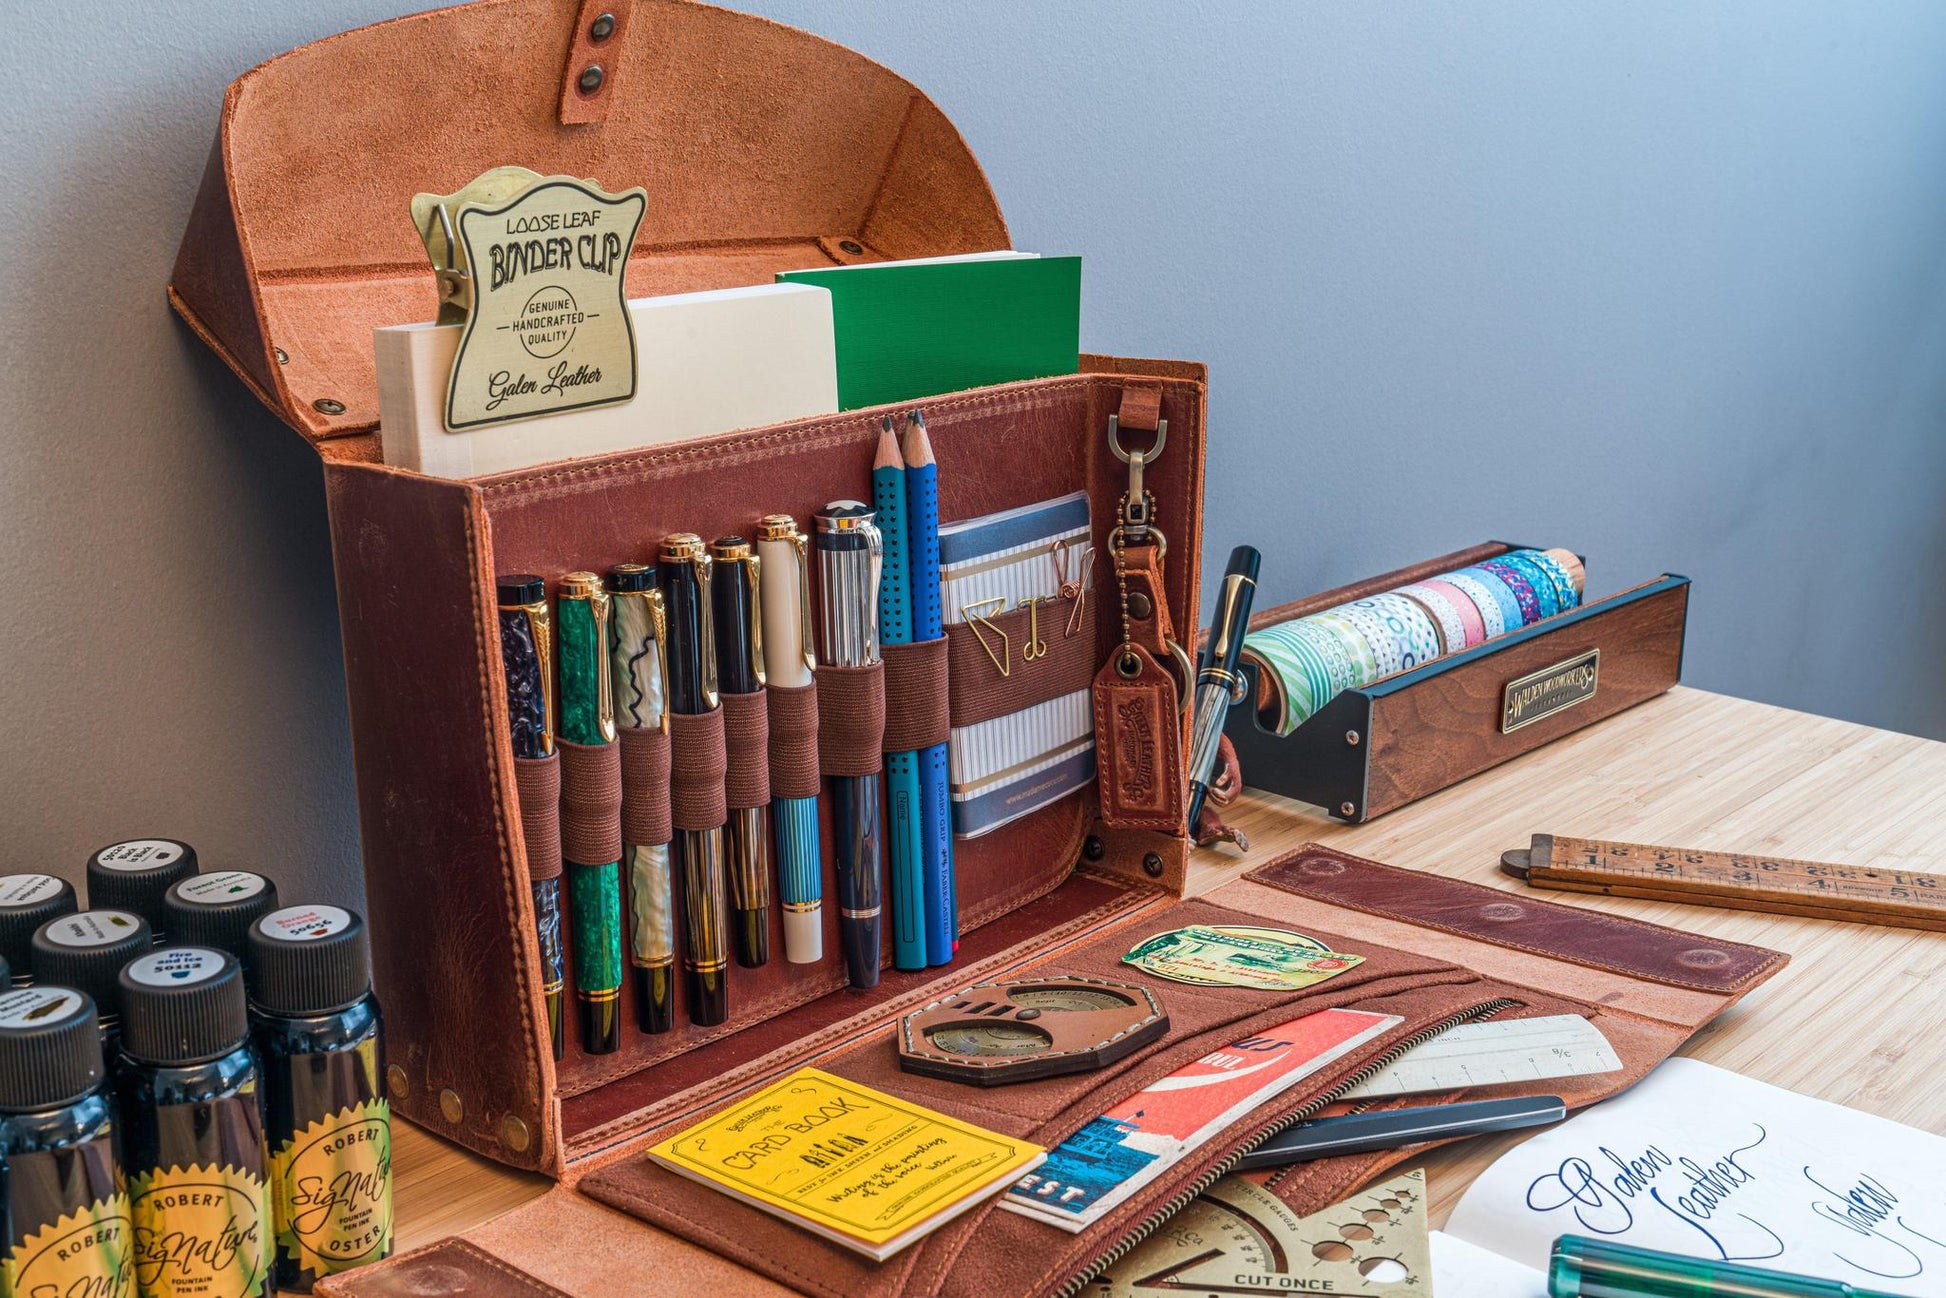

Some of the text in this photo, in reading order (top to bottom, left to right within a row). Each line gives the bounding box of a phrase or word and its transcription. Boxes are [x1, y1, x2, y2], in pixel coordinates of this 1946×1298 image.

[506, 210, 602, 235] LOOSE LEAF
[489, 231, 622, 293] BINDER CLIP
[529, 299, 571, 314] GENUINE
[512, 312, 585, 332] HANDCRAFTED
[528, 330, 568, 345] QUALITY
[486, 361, 603, 411] Galen Leather
[898, 796, 907, 821] Name
[937, 781, 945, 816] JUMBO
[1655, 862, 1675, 873] 2
[1807, 879, 1831, 890] 4
[1890, 887, 1910, 898] 5
[154, 963, 202, 974] 50112
[323, 1128, 380, 1156] ROBERT
[722, 1097, 870, 1170] CARD BOOK
[883, 1125, 919, 1146] SHADING
[826, 1177, 876, 1203] Writing
[881, 1161, 902, 1174] the
[902, 1136, 948, 1165] painting
[861, 1161, 924, 1199] of the voice
[154, 1193, 225, 1212] ROBERT
[1234, 1183, 1300, 1232] CIRCLE GAUGES
[339, 1208, 373, 1225] FOUNTAIN
[343, 1218, 370, 1232] PEN INK
[57, 1227, 120, 1262] ROBERT
[329, 1225, 381, 1252] OSTER
[171, 1276, 213, 1286] FOUNTAIN
[176, 1285, 209, 1294] PEN INK
[1234, 1274, 1335, 1292] CUT ONCE
